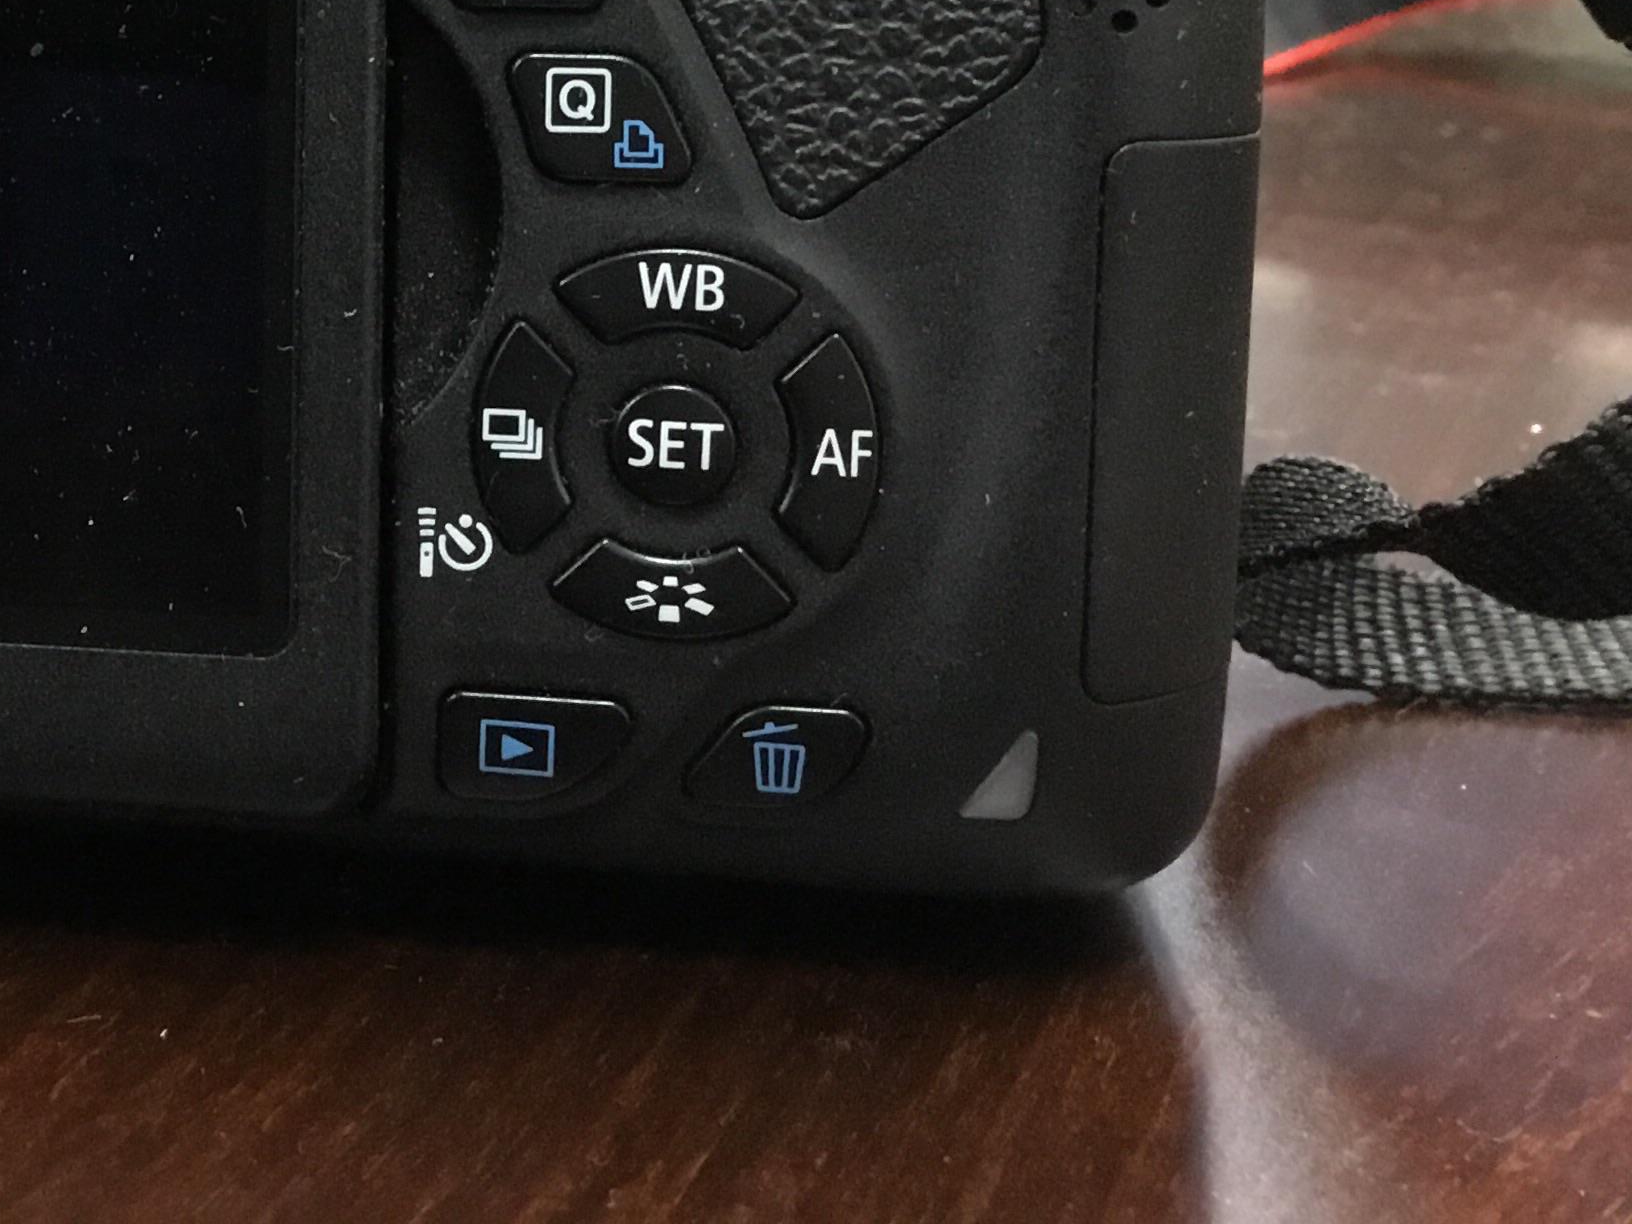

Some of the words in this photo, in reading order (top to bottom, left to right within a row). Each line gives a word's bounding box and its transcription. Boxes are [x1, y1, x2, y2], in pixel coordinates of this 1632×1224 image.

[558, 79, 596, 121] Q
[638, 261, 725, 312] WB
[627, 418, 725, 471] SET
[810, 428, 874, 477] AF
